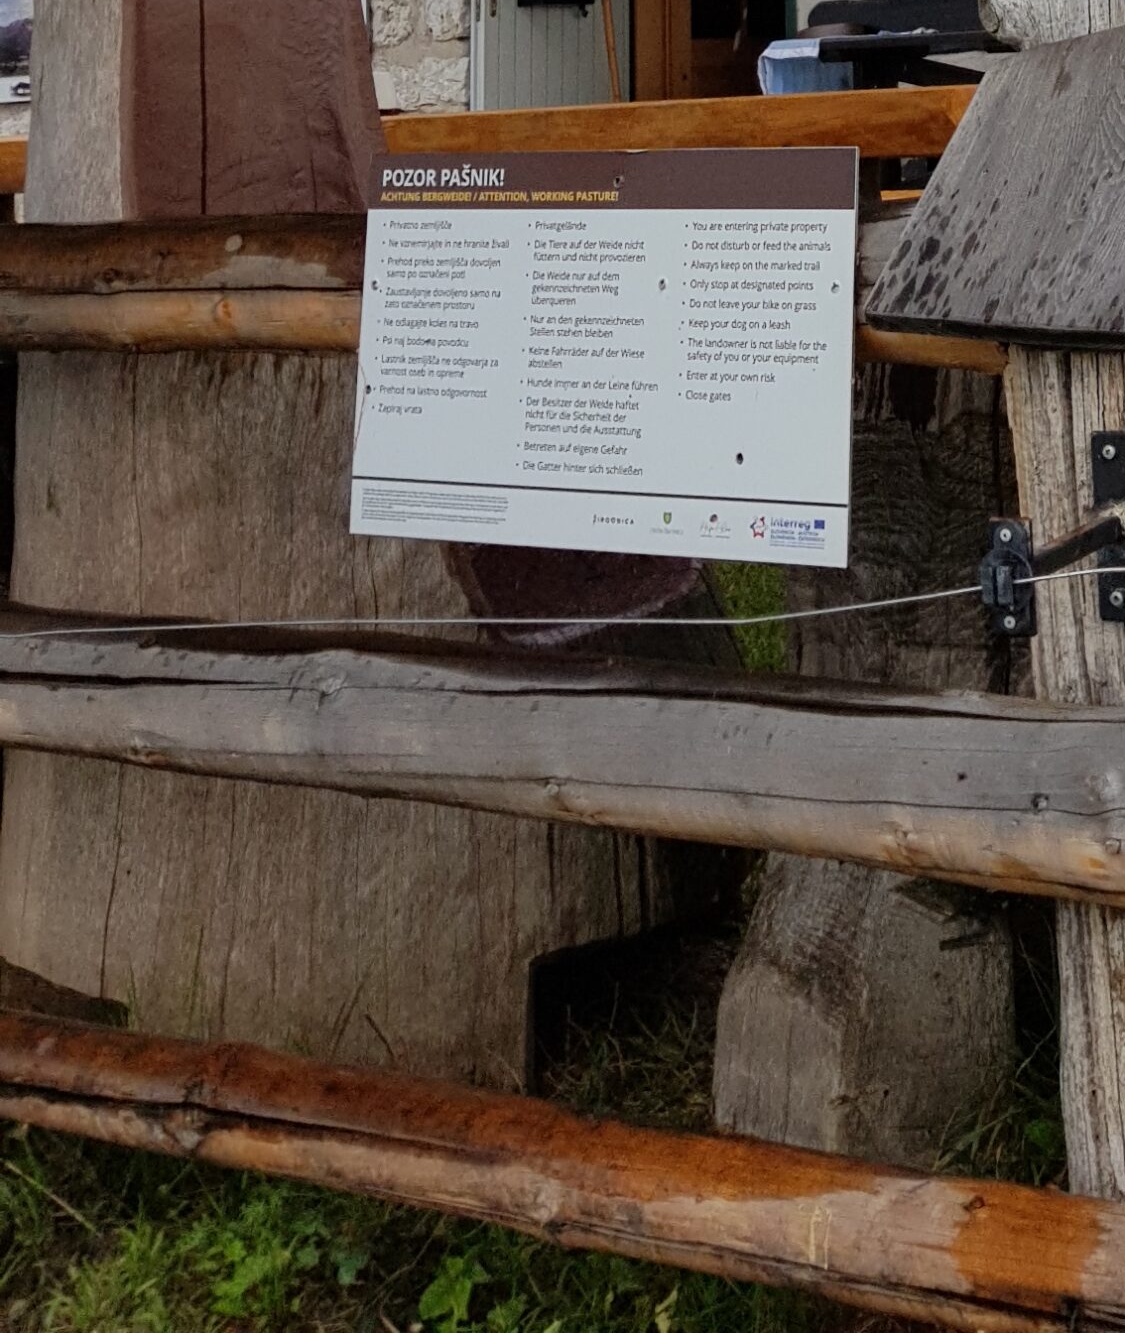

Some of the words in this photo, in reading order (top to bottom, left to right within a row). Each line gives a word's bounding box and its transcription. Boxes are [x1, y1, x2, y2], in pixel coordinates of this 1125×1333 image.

[382, 168, 437, 187] POZOR
[440, 163, 505, 187] PAŠNIK!
[380, 192, 420, 201] ACHTUNG
[479, 191, 529, 203] ATTENTION,
[531, 191, 574, 201] WORKING
[576, 191, 618, 201] PASTURE!
[692, 222, 708, 231] You
[709, 223, 723, 231] are
[725, 222, 758, 233] entering
[760, 222, 789, 234] private
[790, 223, 828, 234] property
[692, 241, 703, 250] Do
[705, 242, 719, 250] not
[721, 241, 749, 250] disturb
[752, 243, 760, 251] or
[763, 241, 781, 251] feed
[783, 241, 797, 251] the
[799, 241, 831, 251] animals
[690, 261, 719, 272] Always
[721, 261, 740, 272] keep
[742, 262, 753, 270] on
[755, 261, 768, 270] the
[771, 261, 802, 271] marked
[804, 261, 820, 271] trail
[690, 280, 709, 292] Only
[711, 281, 729, 291] stop
[731, 281, 739, 289] at
[741, 280, 786, 292] designated
[788, 281, 814, 293] points
[689, 299, 701, 308] Do
[703, 300, 717, 308] not
[719, 299, 740, 309] leave
[741, 302, 760, 312] your
[762, 299, 779, 309] bike
[781, 302, 792, 310] on
[794, 302, 816, 313] grass
[689, 319, 709, 331] Keep
[710, 321, 729, 331] your
[731, 319, 747, 331] dog
[749, 321, 759, 329] on
[769, 319, 790, 330] leash
[688, 338, 703, 347] The
[705, 338, 748, 348] landowner
[759, 341, 773, 349] not
[775, 340, 797, 350] liable
[799, 340, 811, 350] for
[813, 341, 827, 351] the
[687, 351, 712, 363] safety
[714, 351, 723, 361] of
[724, 354, 739, 364] you
[742, 354, 751, 362] or
[752, 354, 771, 364] your
[773, 353, 819, 365] equipment
[687, 371, 708, 380] Enter
[710, 373, 718, 381] at
[720, 373, 738, 383] your
[741, 374, 758, 382] own
[761, 373, 775, 382] risk
[685, 391, 708, 400] Close
[709, 392, 731, 403] gates
